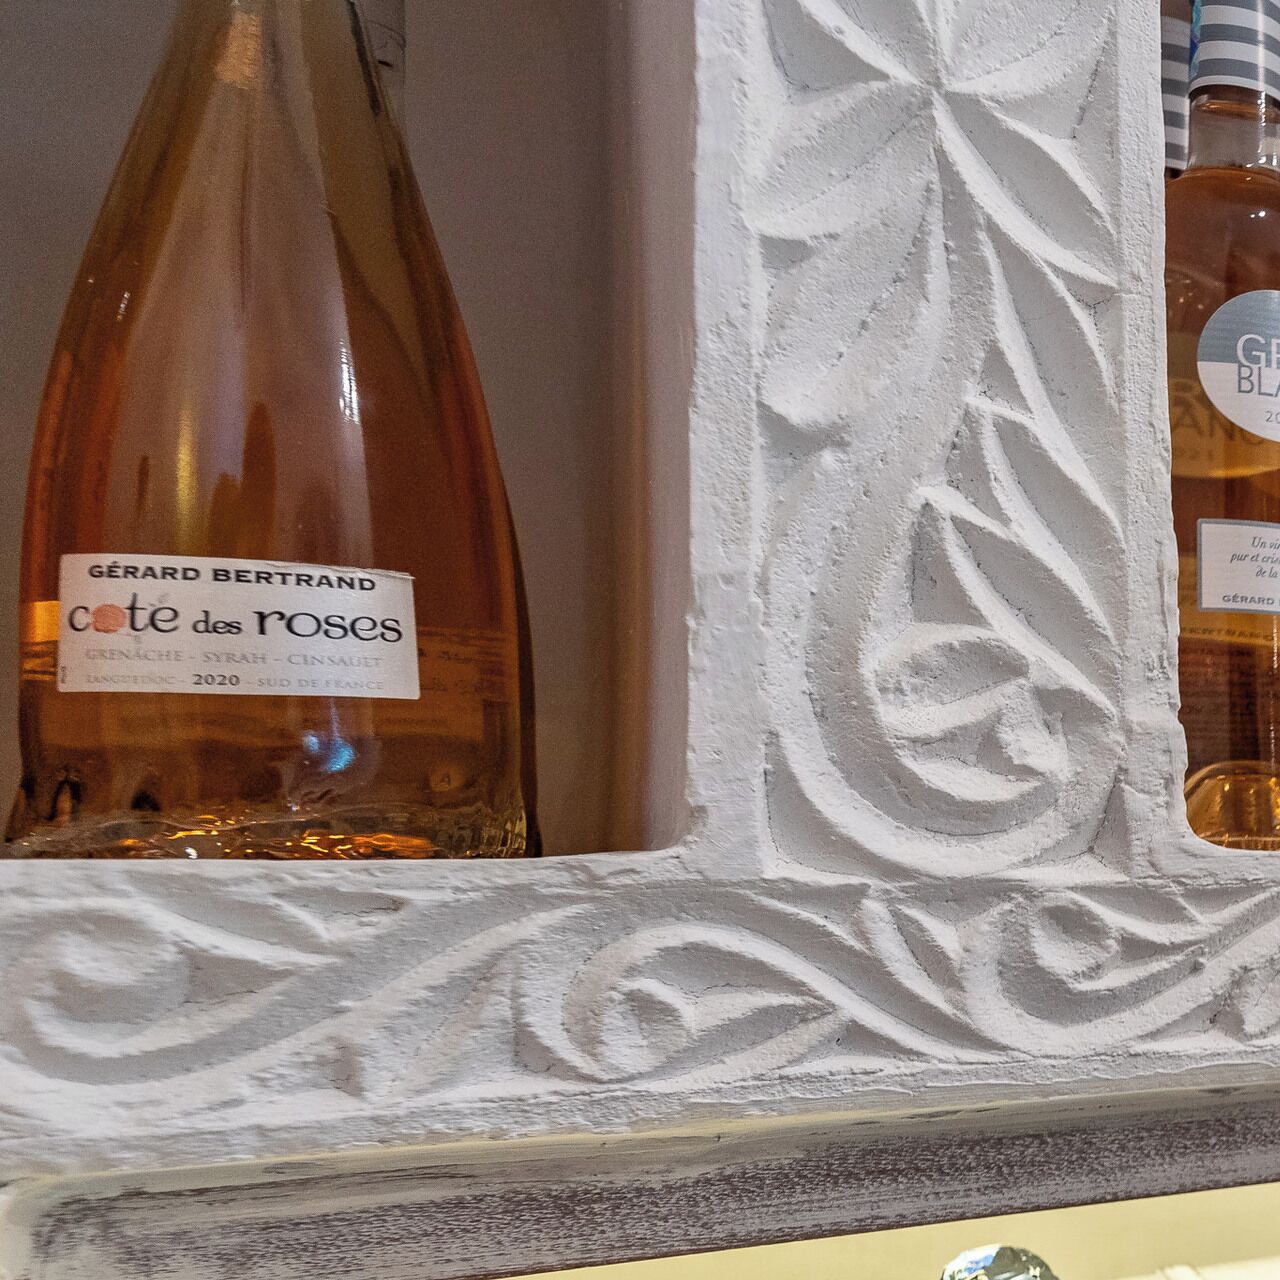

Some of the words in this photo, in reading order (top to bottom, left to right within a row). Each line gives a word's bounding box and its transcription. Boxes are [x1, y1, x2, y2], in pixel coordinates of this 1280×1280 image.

[1229, 553, 1250, 564] pur
[87, 560, 202, 581] GÉRARD
[211, 567, 377, 592] BERTRAND
[1222, 592, 1275, 606] GÉRARD
[191, 610, 243, 635] des
[252, 609, 404, 643] roses
[202, 651, 267, 664] SYRAH
[191, 673, 241, 687] 2020
[256, 677, 293, 688] SUD
[297, 678, 319, 689] DE
[324, 679, 385, 691] FRANCE
